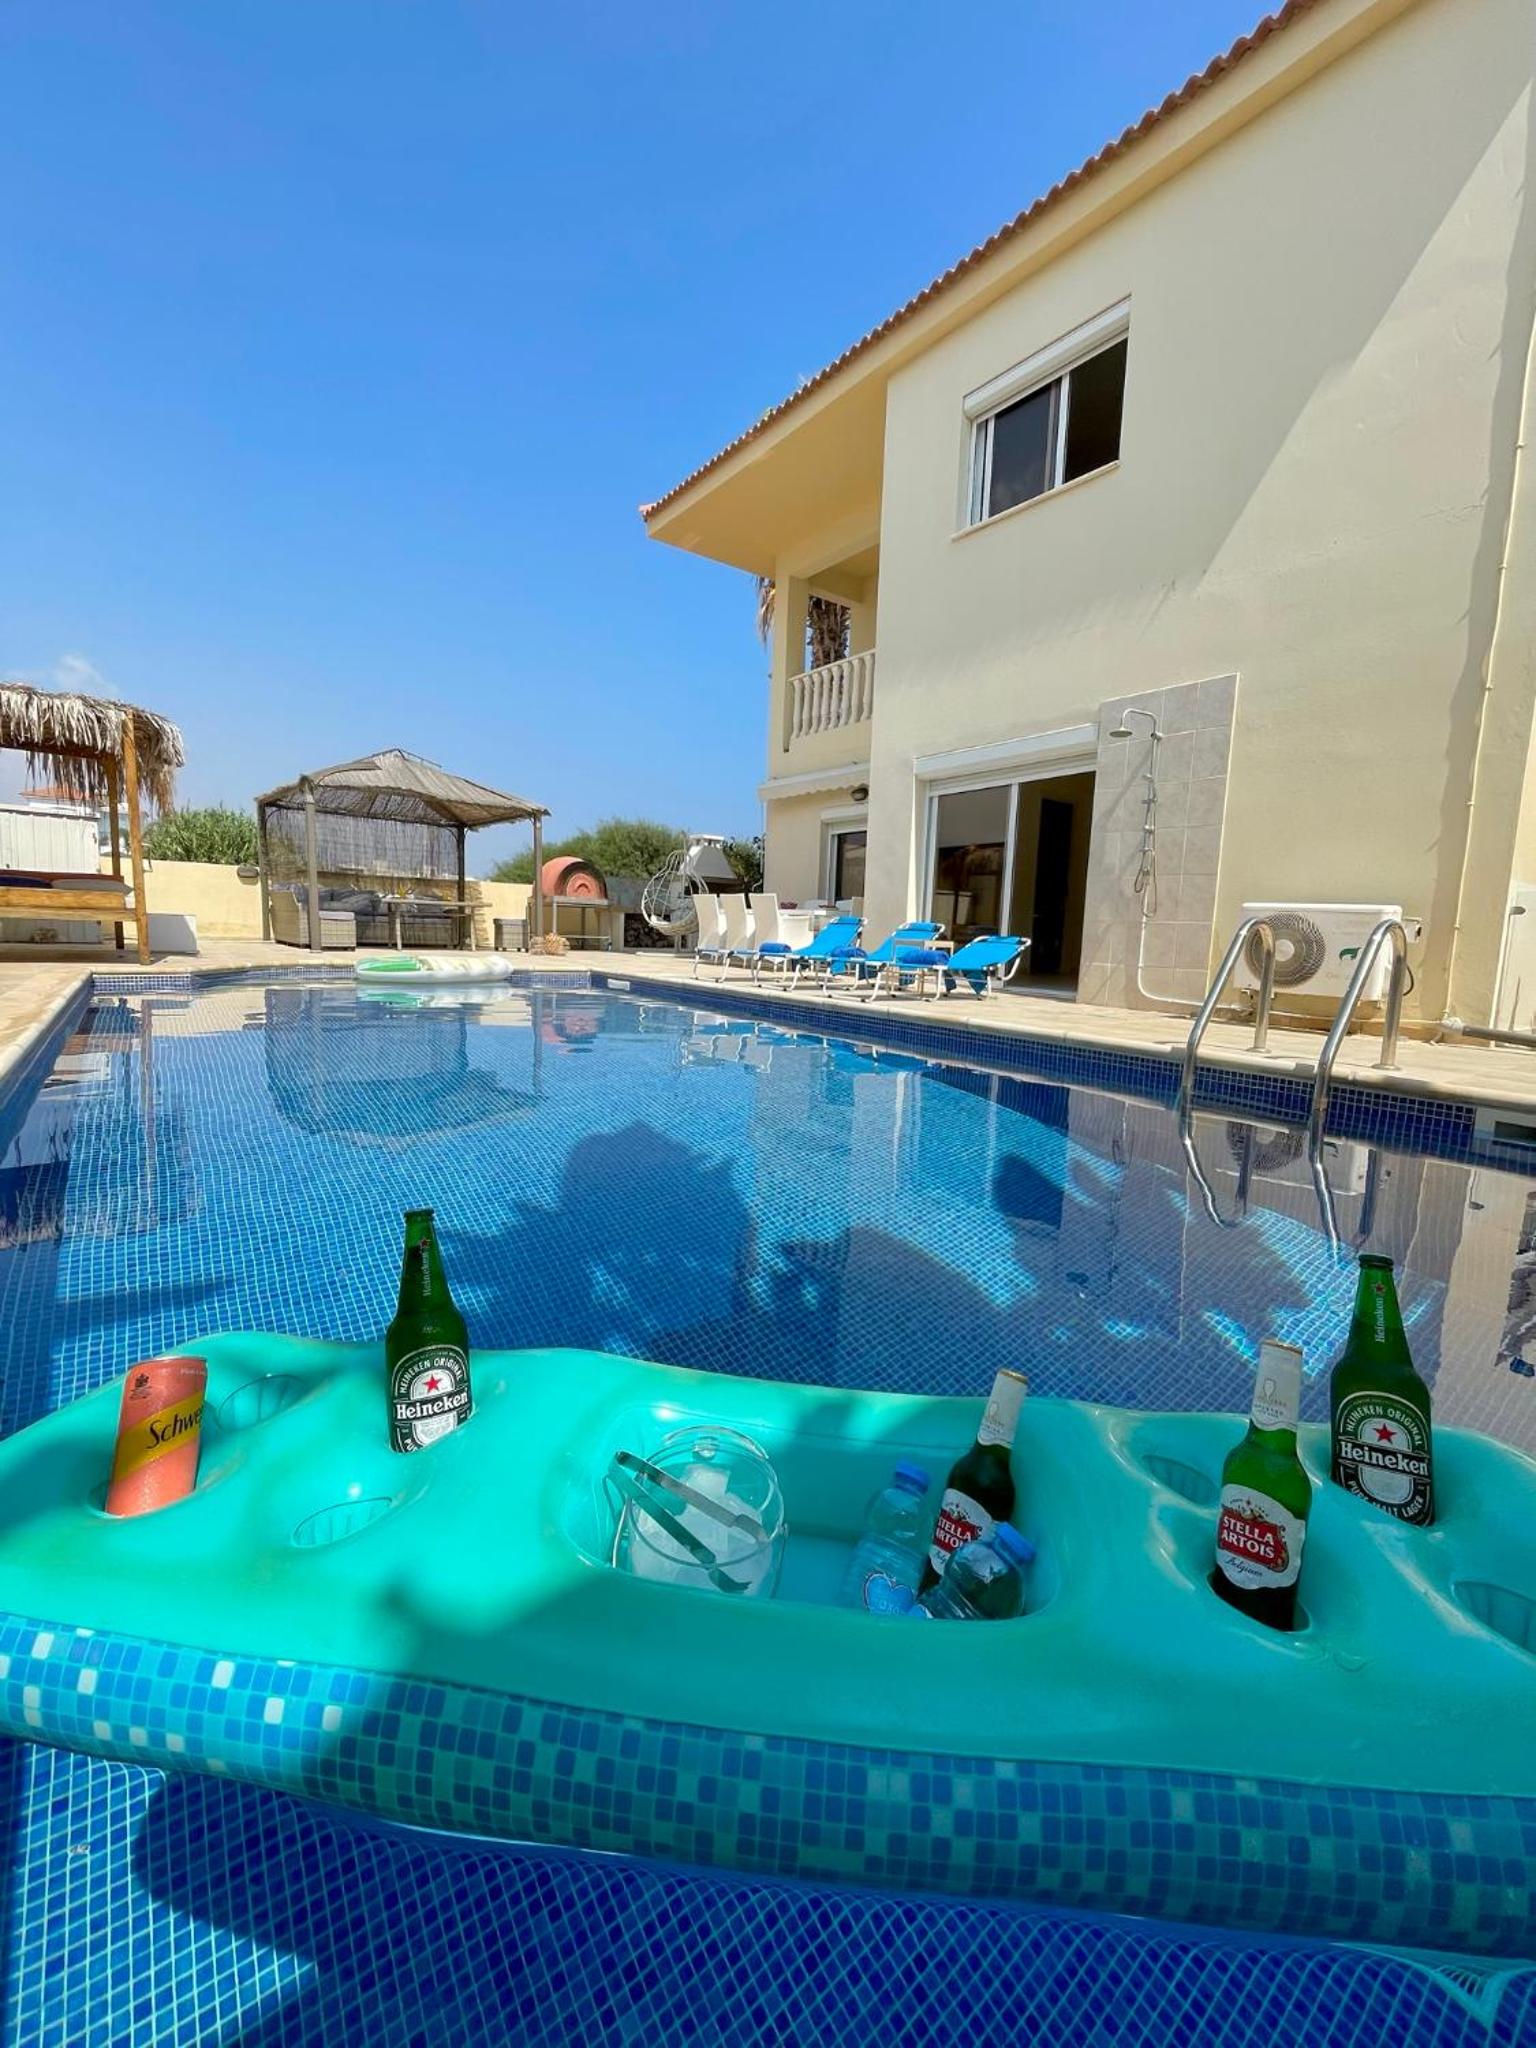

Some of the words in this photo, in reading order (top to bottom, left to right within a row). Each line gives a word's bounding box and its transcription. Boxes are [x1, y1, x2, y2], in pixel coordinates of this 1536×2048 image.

[1375, 1297, 1385, 1343] Heineken
[400, 1360, 431, 1394] HEINEKEN
[434, 1357, 463, 1381] ORIGINAL
[396, 1391, 468, 1420] Heineken
[1346, 1405, 1383, 1432] HEINEKEN
[1387, 1408, 1422, 1445] ORIGINAL
[1340, 1441, 1429, 1476] Heineken
[1402, 1495, 1424, 1517] LAGER
[1222, 1529, 1274, 1559] ARTOIS
[1223, 1515, 1274, 1545] STELLA
